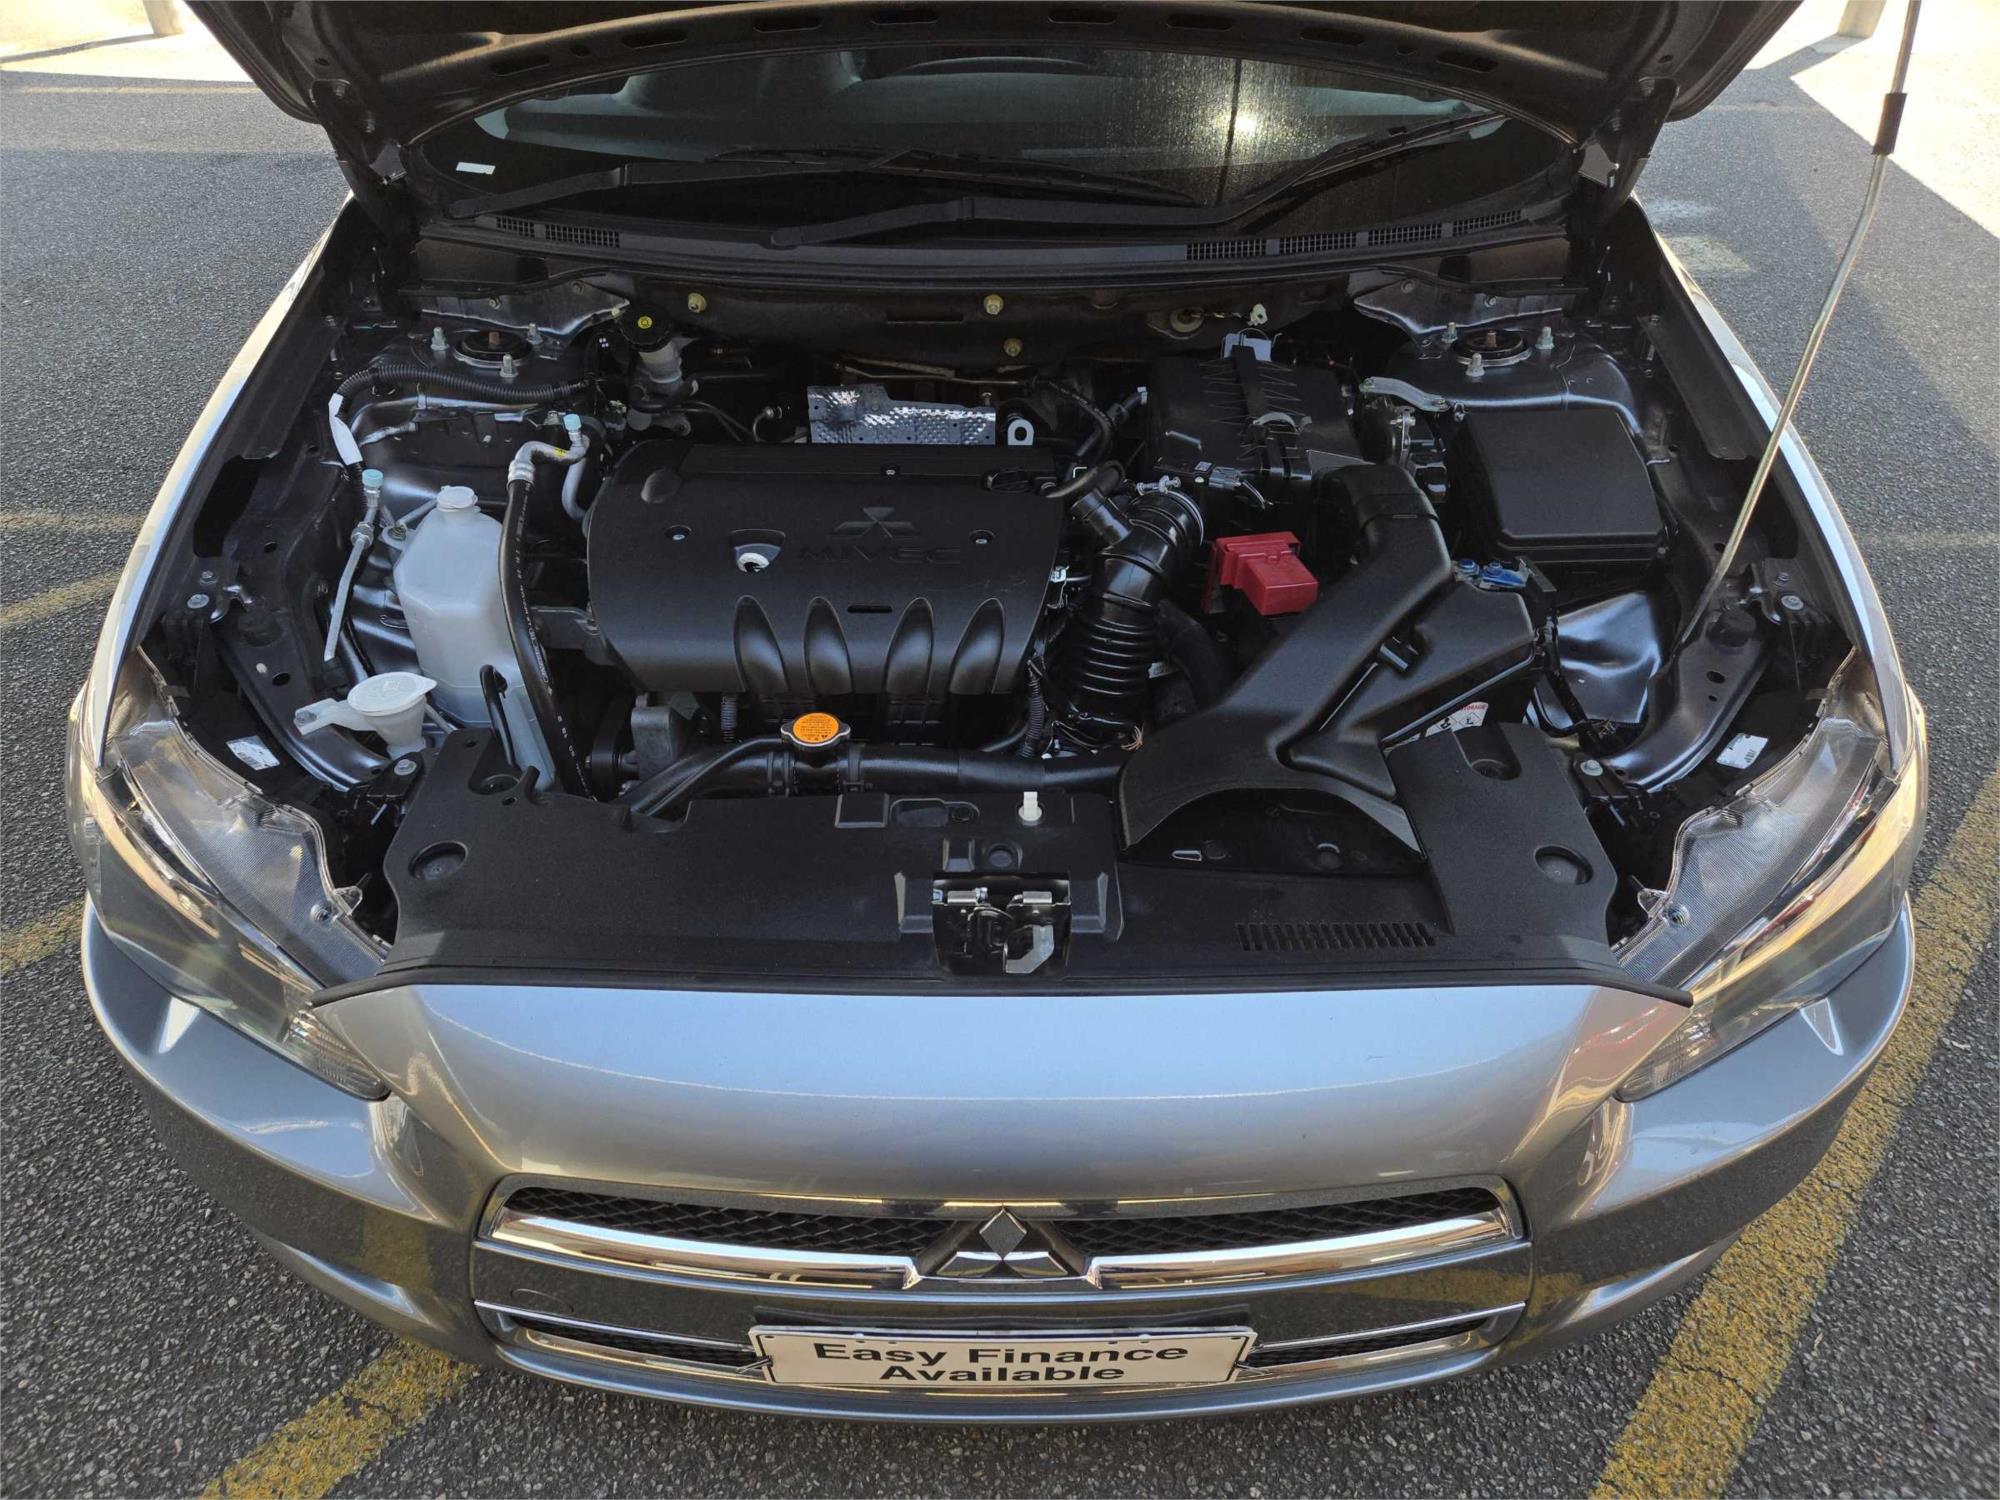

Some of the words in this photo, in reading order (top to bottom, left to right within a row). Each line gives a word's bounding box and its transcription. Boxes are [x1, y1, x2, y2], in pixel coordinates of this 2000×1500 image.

[799, 546, 961, 564] MIVEC
[813, 1342, 947, 1367] Easy
[969, 1347, 1189, 1364] Finance
[880, 1365, 1125, 1382] Available
